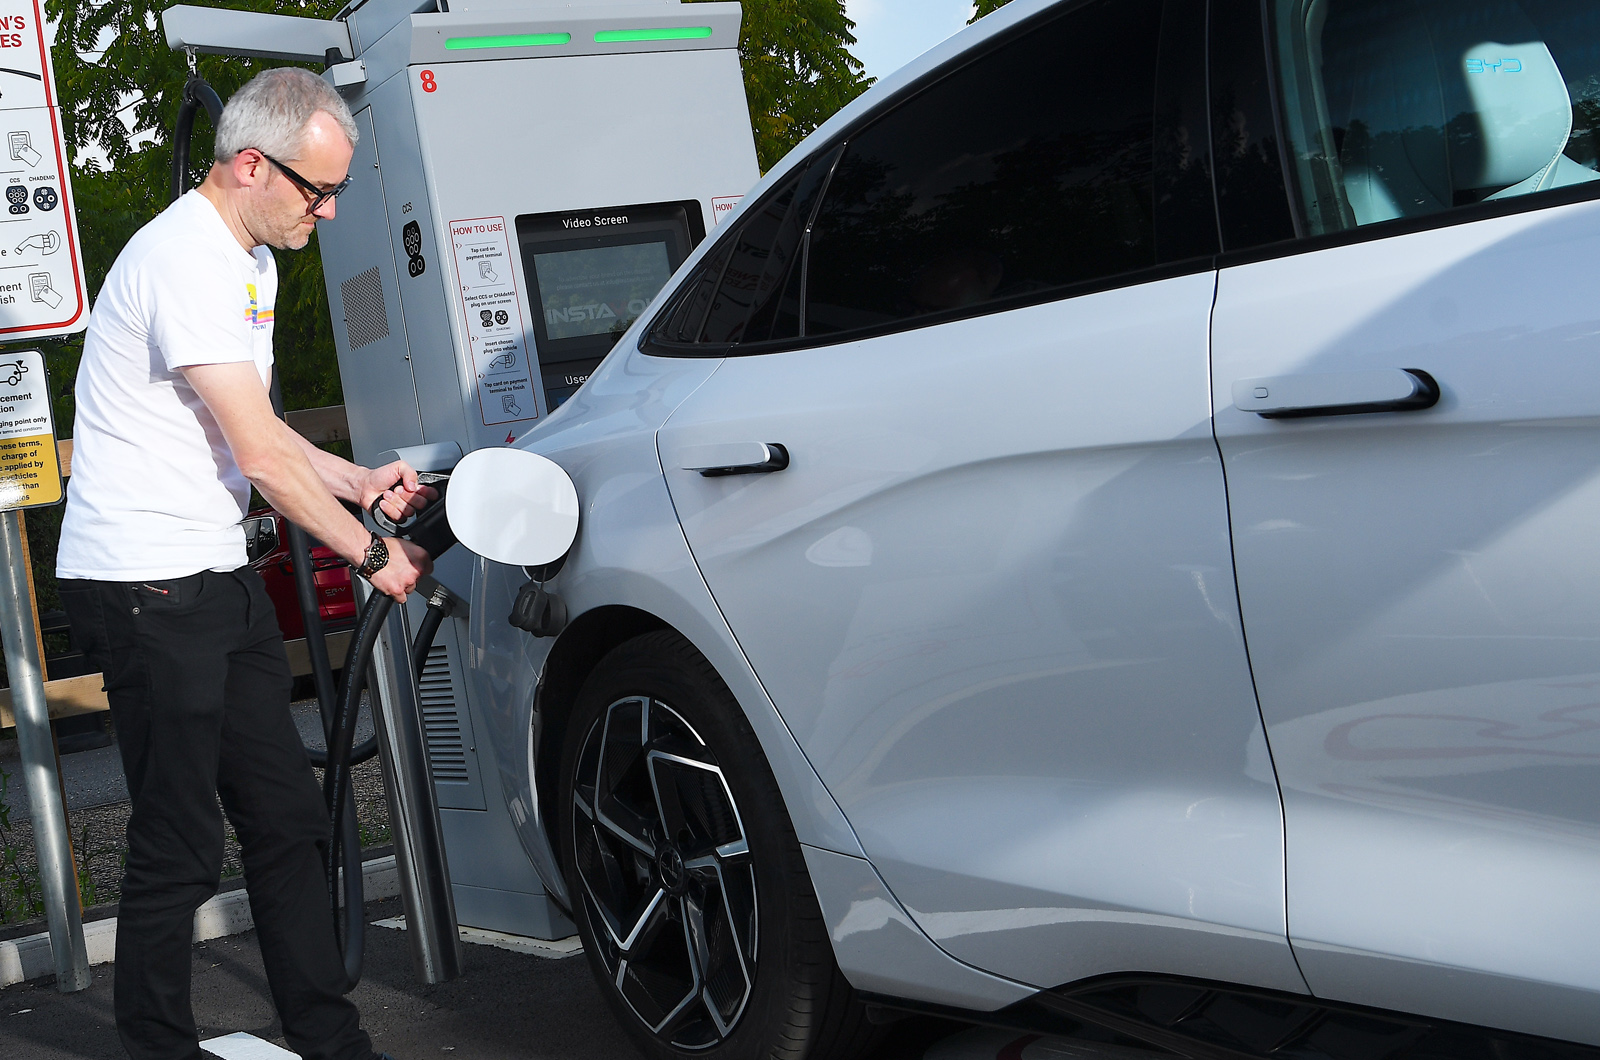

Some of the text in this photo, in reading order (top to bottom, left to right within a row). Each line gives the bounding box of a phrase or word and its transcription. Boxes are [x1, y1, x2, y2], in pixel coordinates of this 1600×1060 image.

[0, 33, 23, 48] ES
[1465, 58, 1522, 73] BYD
[419, 69, 437, 93] 8
[402, 202, 413, 214] CCS
[715, 203, 733, 212] HOW
[562, 215, 629, 229] Video Screen
[452, 223, 503, 236] HOW TO USE
[0, 405, 15, 413] ion
[14, 418, 32, 426] point
[32, 416, 48, 424] only
[18, 440, 43, 449] terms,
[1, 449, 38, 461] charge of
[4, 460, 44, 472] applied by
[22, 482, 40, 490] than
